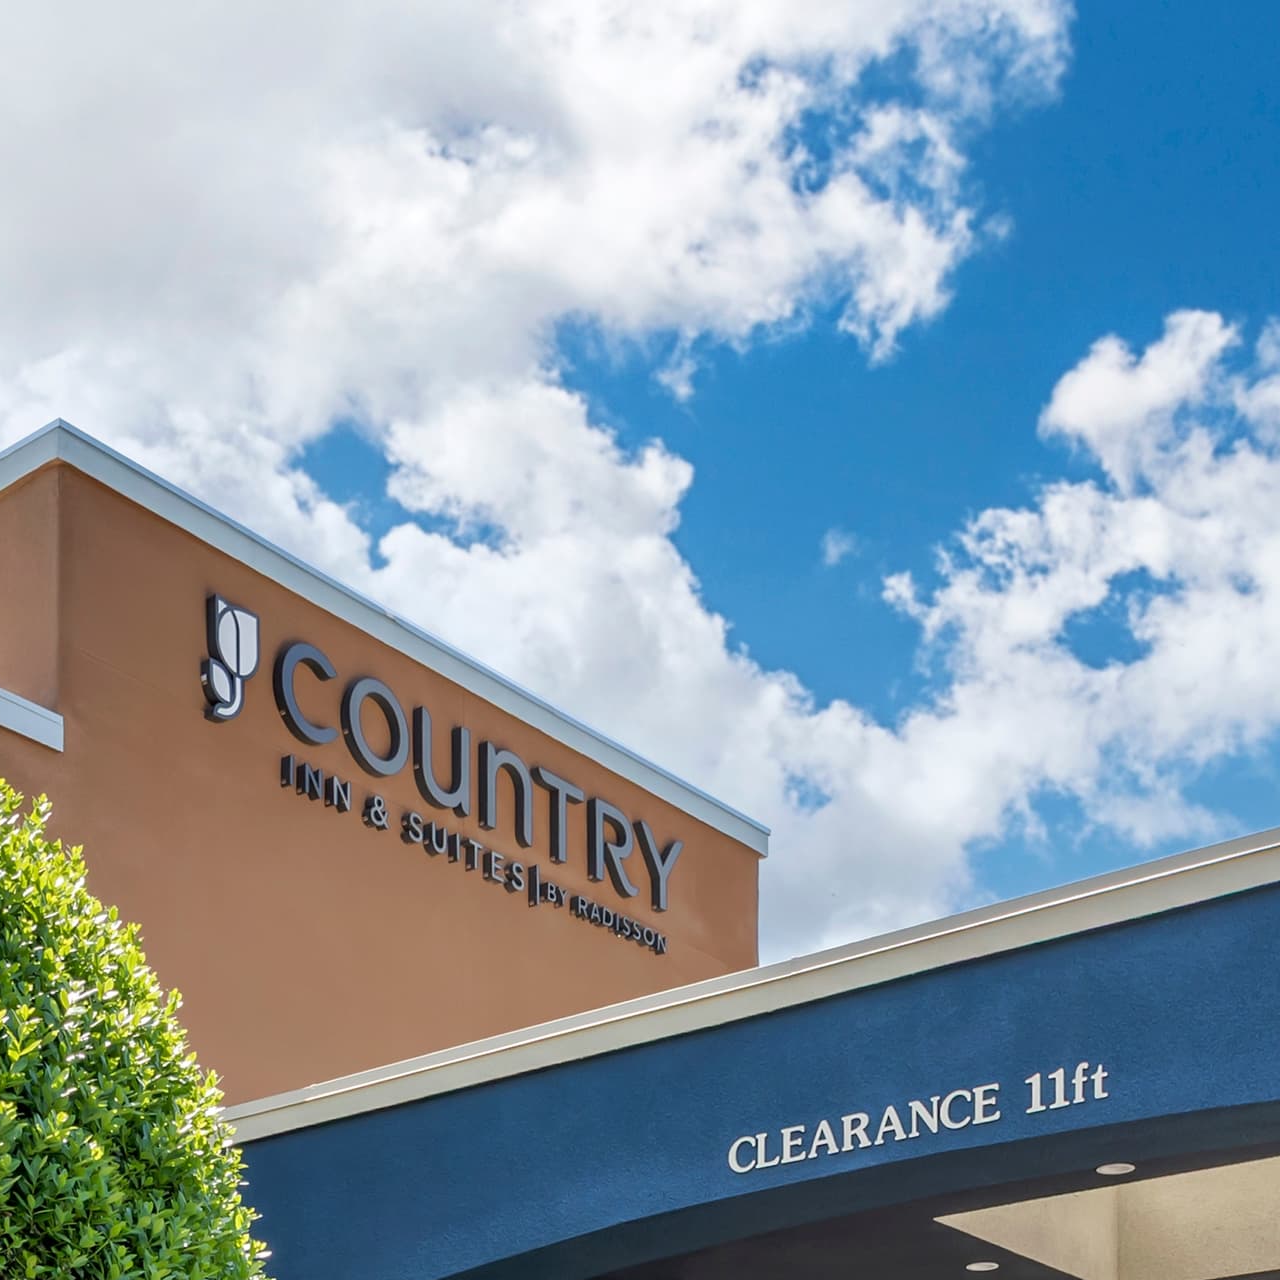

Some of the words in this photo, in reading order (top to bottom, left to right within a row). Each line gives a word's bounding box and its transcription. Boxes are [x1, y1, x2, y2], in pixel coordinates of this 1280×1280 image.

[280, 754, 352, 812] INN
[362, 795, 390, 831] &
[401, 811, 526, 892] SUITES
[543, 881, 570, 908] BY
[570, 895, 668, 955] RADISSON
[727, 1083, 1002, 1175] CLEARANCE
[1024, 1061, 1109, 1115] 11ft
